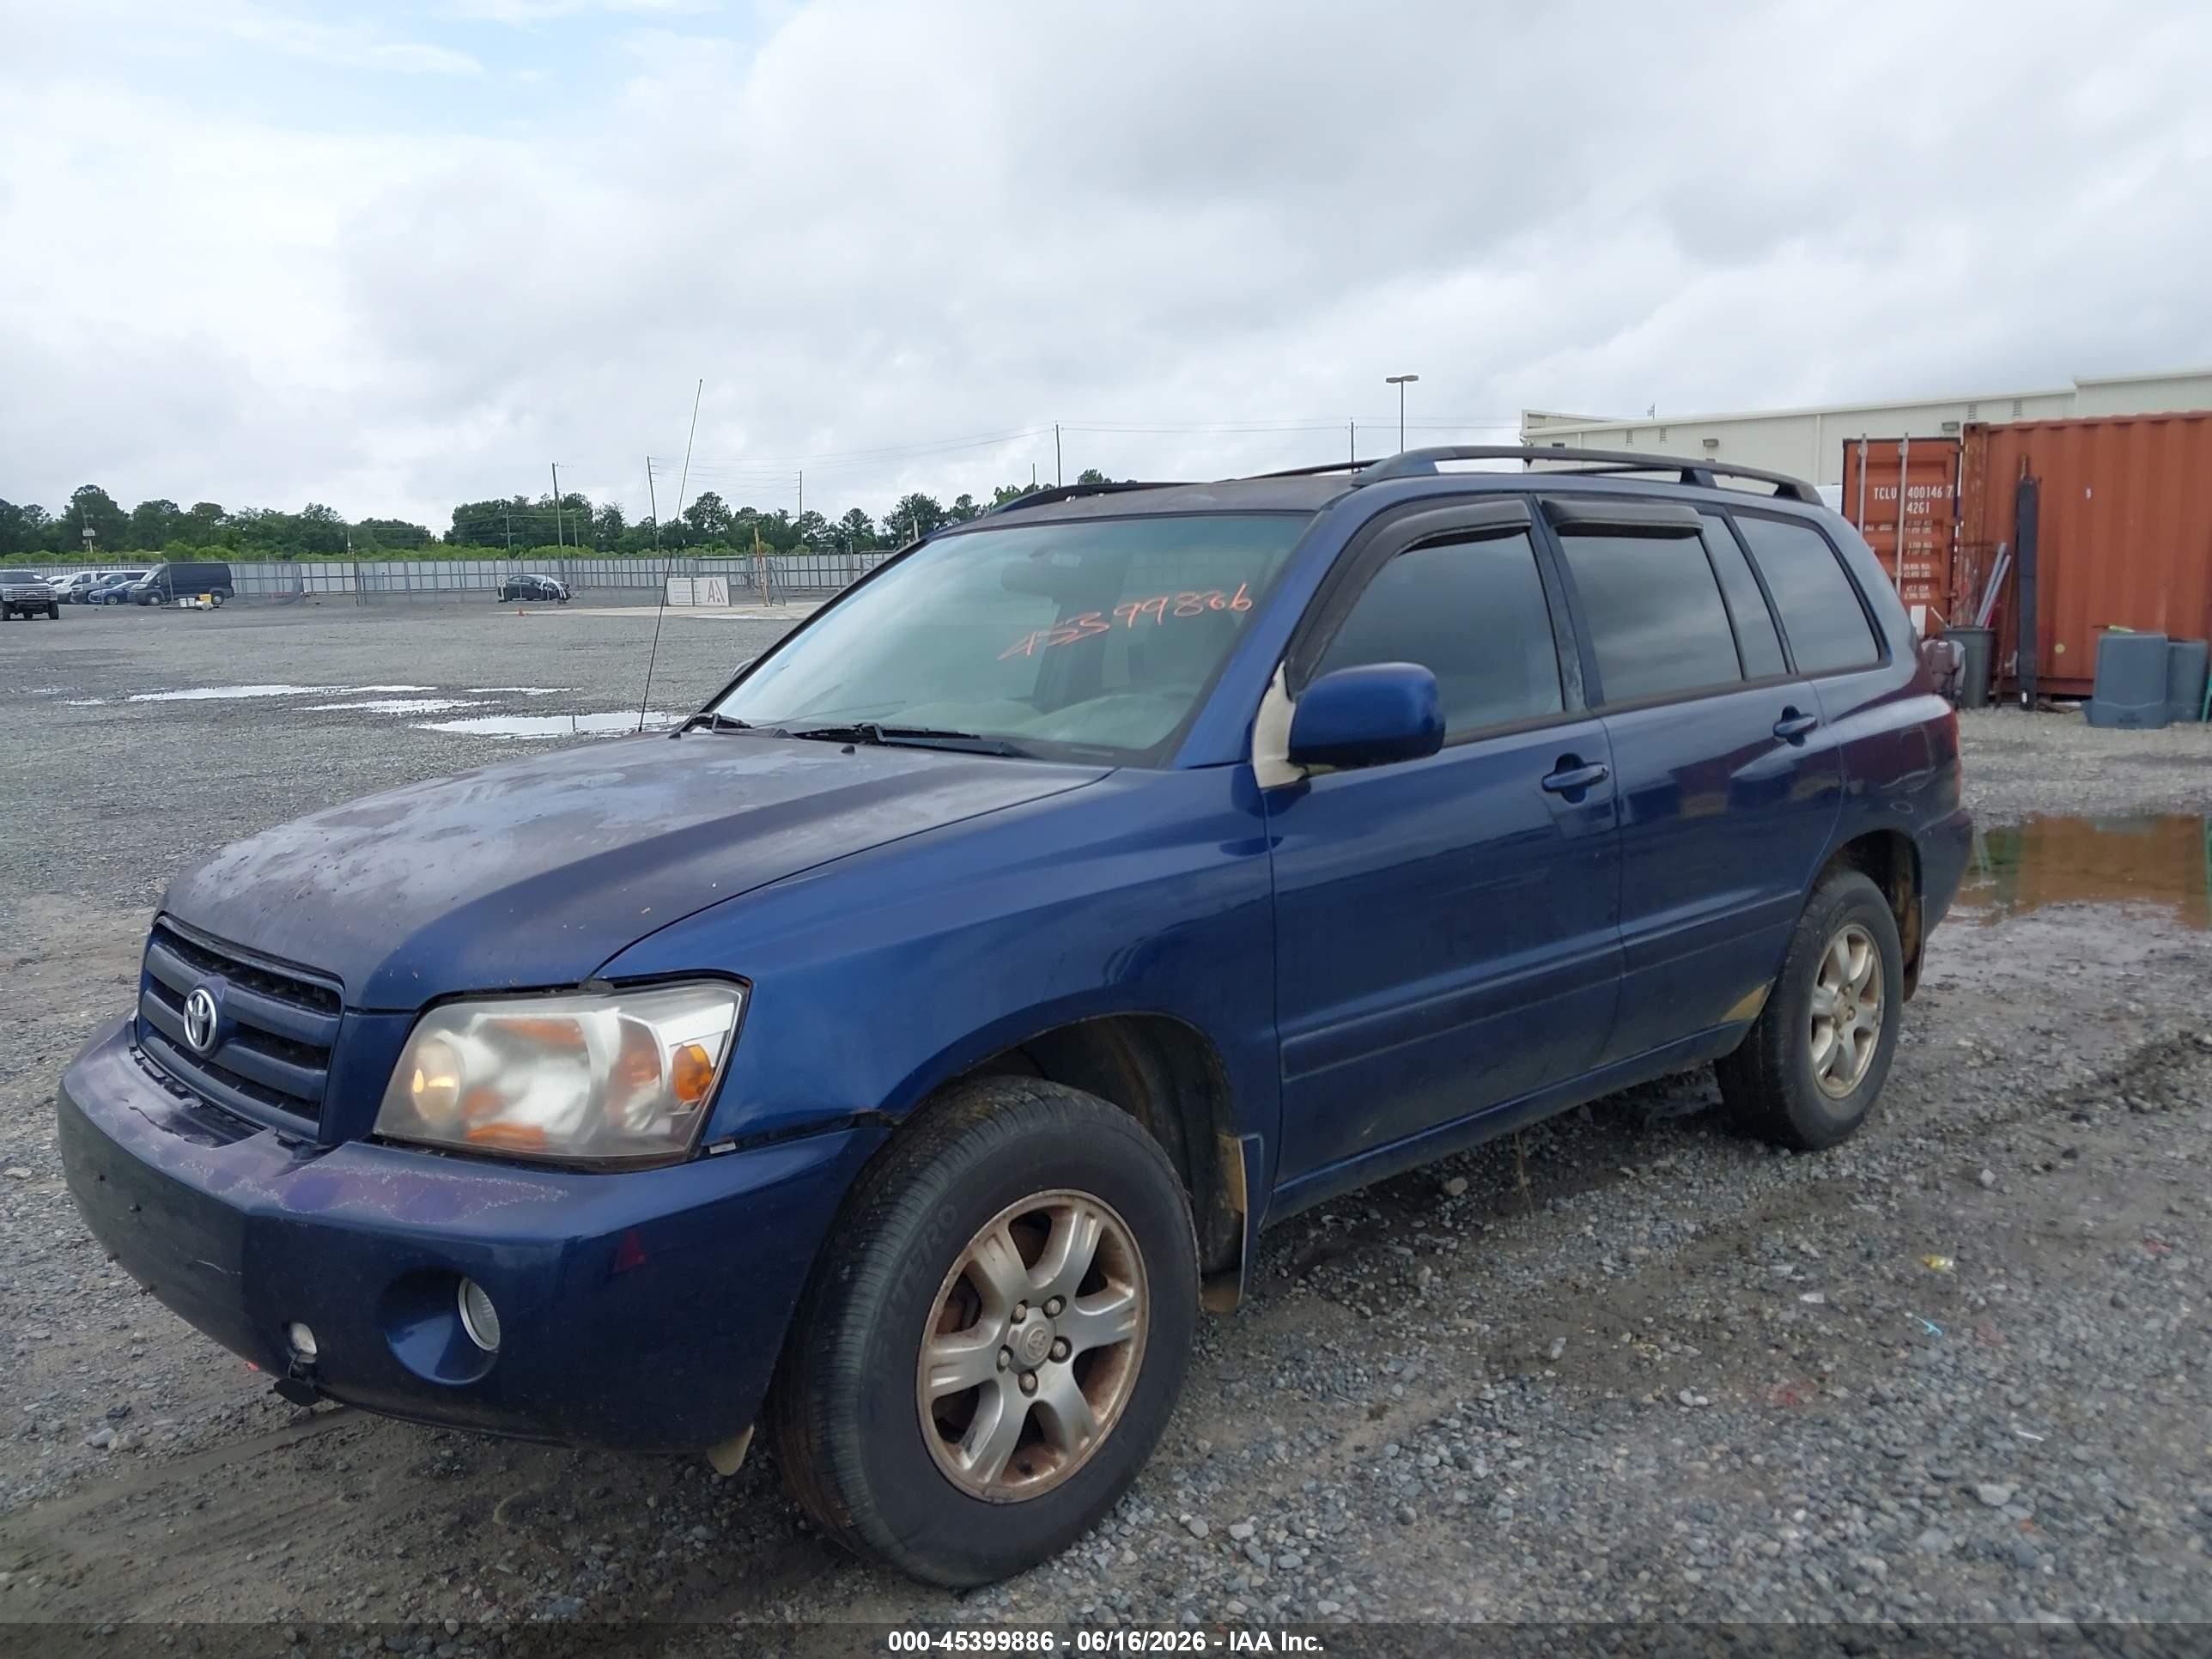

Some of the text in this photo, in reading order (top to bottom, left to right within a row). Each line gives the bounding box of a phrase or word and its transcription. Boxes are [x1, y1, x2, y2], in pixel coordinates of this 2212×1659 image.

[1874, 484, 1954, 500] TCLU 400146 7
